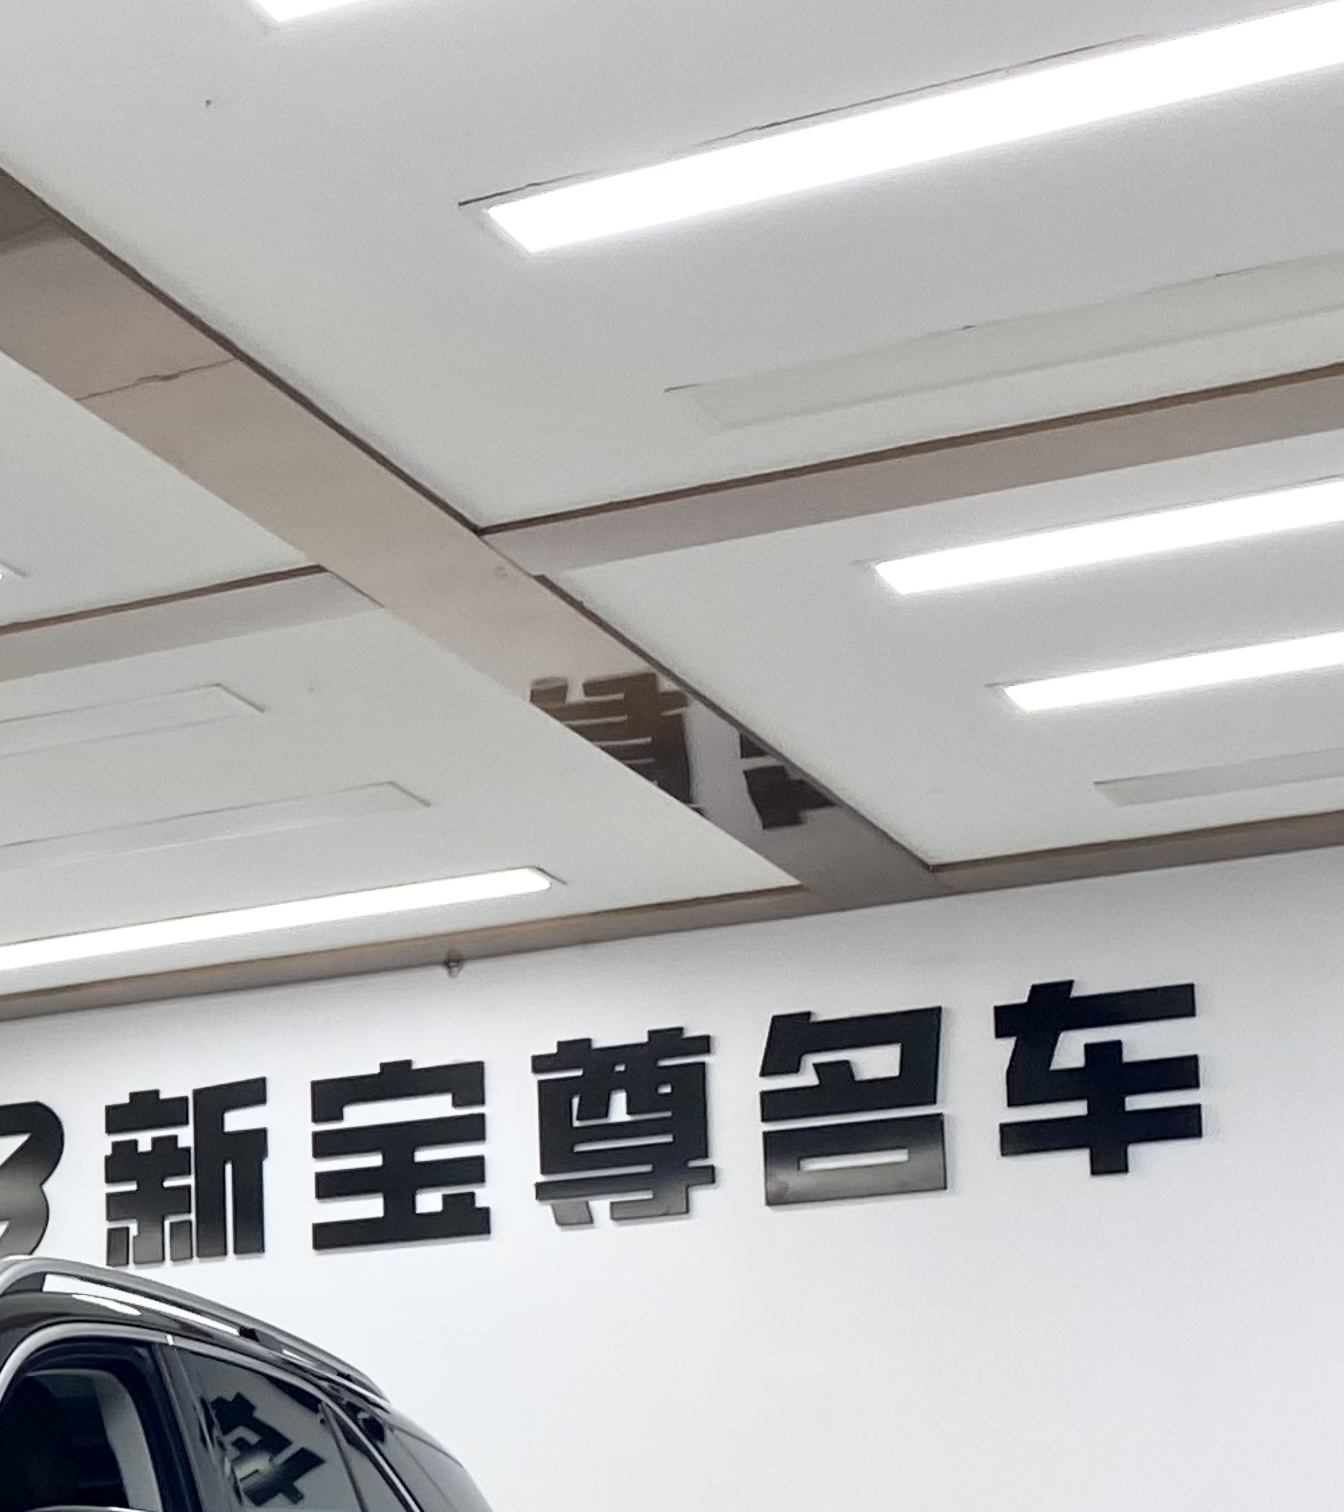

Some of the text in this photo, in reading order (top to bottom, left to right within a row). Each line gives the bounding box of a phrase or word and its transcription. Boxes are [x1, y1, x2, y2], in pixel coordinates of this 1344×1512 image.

[104, 979, 1203, 1268] 新宝尊名车
